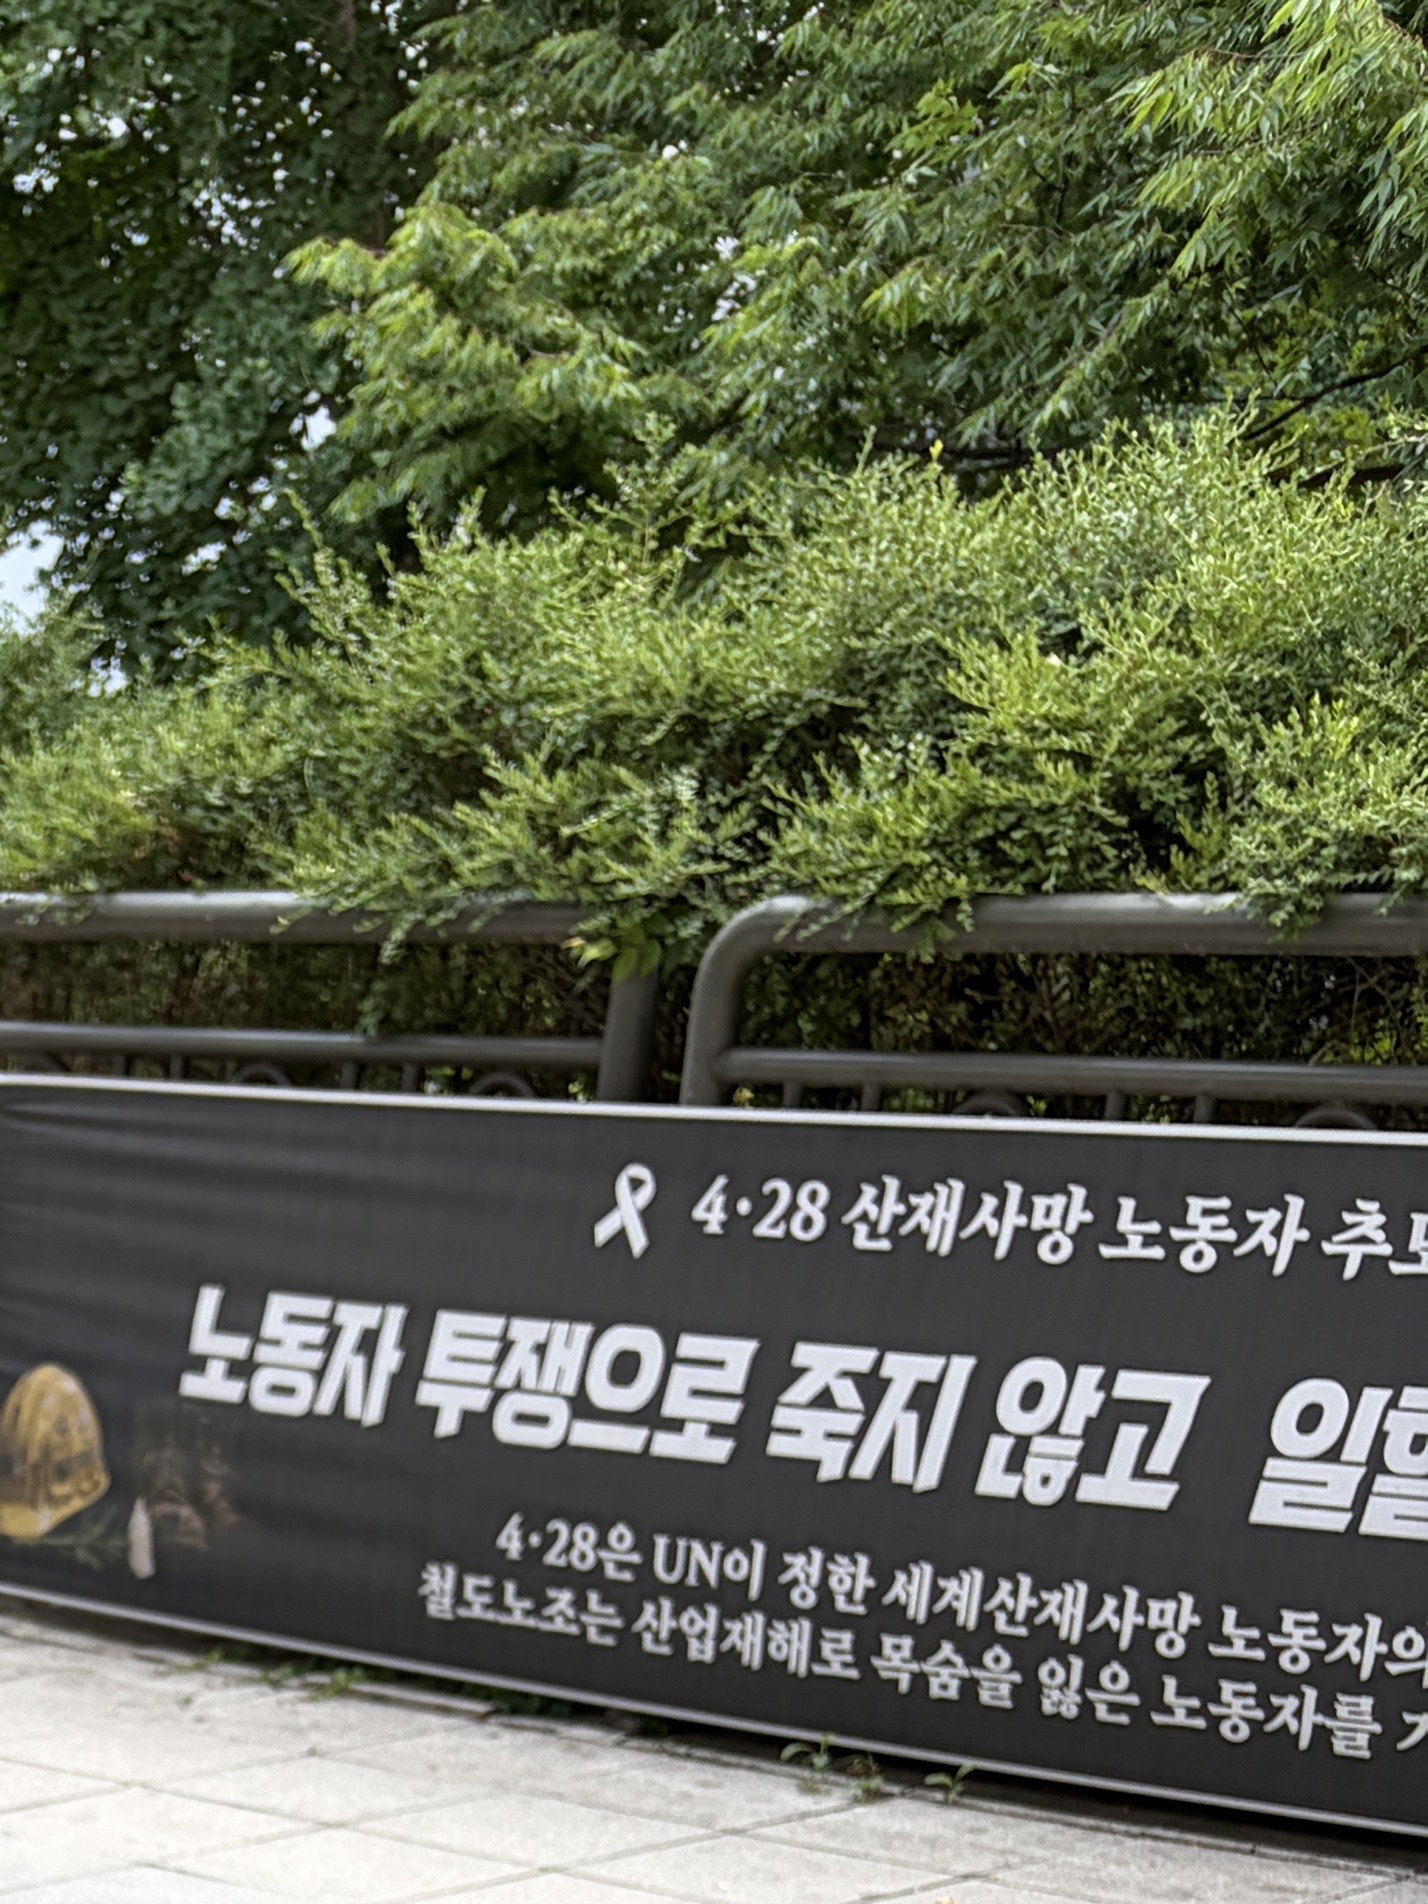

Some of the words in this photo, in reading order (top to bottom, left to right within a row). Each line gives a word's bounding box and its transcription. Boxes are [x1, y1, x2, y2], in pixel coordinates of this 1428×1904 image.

[841, 1174, 1093, 1265] 산재사망
[1097, 1193, 1310, 1277] 노동자
[179, 1283, 409, 1428] 노동자
[415, 1308, 761, 1465] 투쟁으로
[766, 1341, 978, 1494] 죽지
[975, 1356, 1212, 1511] 않고
[418, 1560, 625, 1648] 철도노조는
[632, 1595, 861, 1680] 산업재해로
[870, 1632, 1022, 1710] 목숨을
[1038, 1653, 1141, 1726] 잃은
[1150, 1674, 1383, 1760] 노동자를
[652, 1532, 767, 1602] UN이
[777, 1546, 877, 1616] 정한
[882, 1560, 1201, 1660] 세계산재사망
